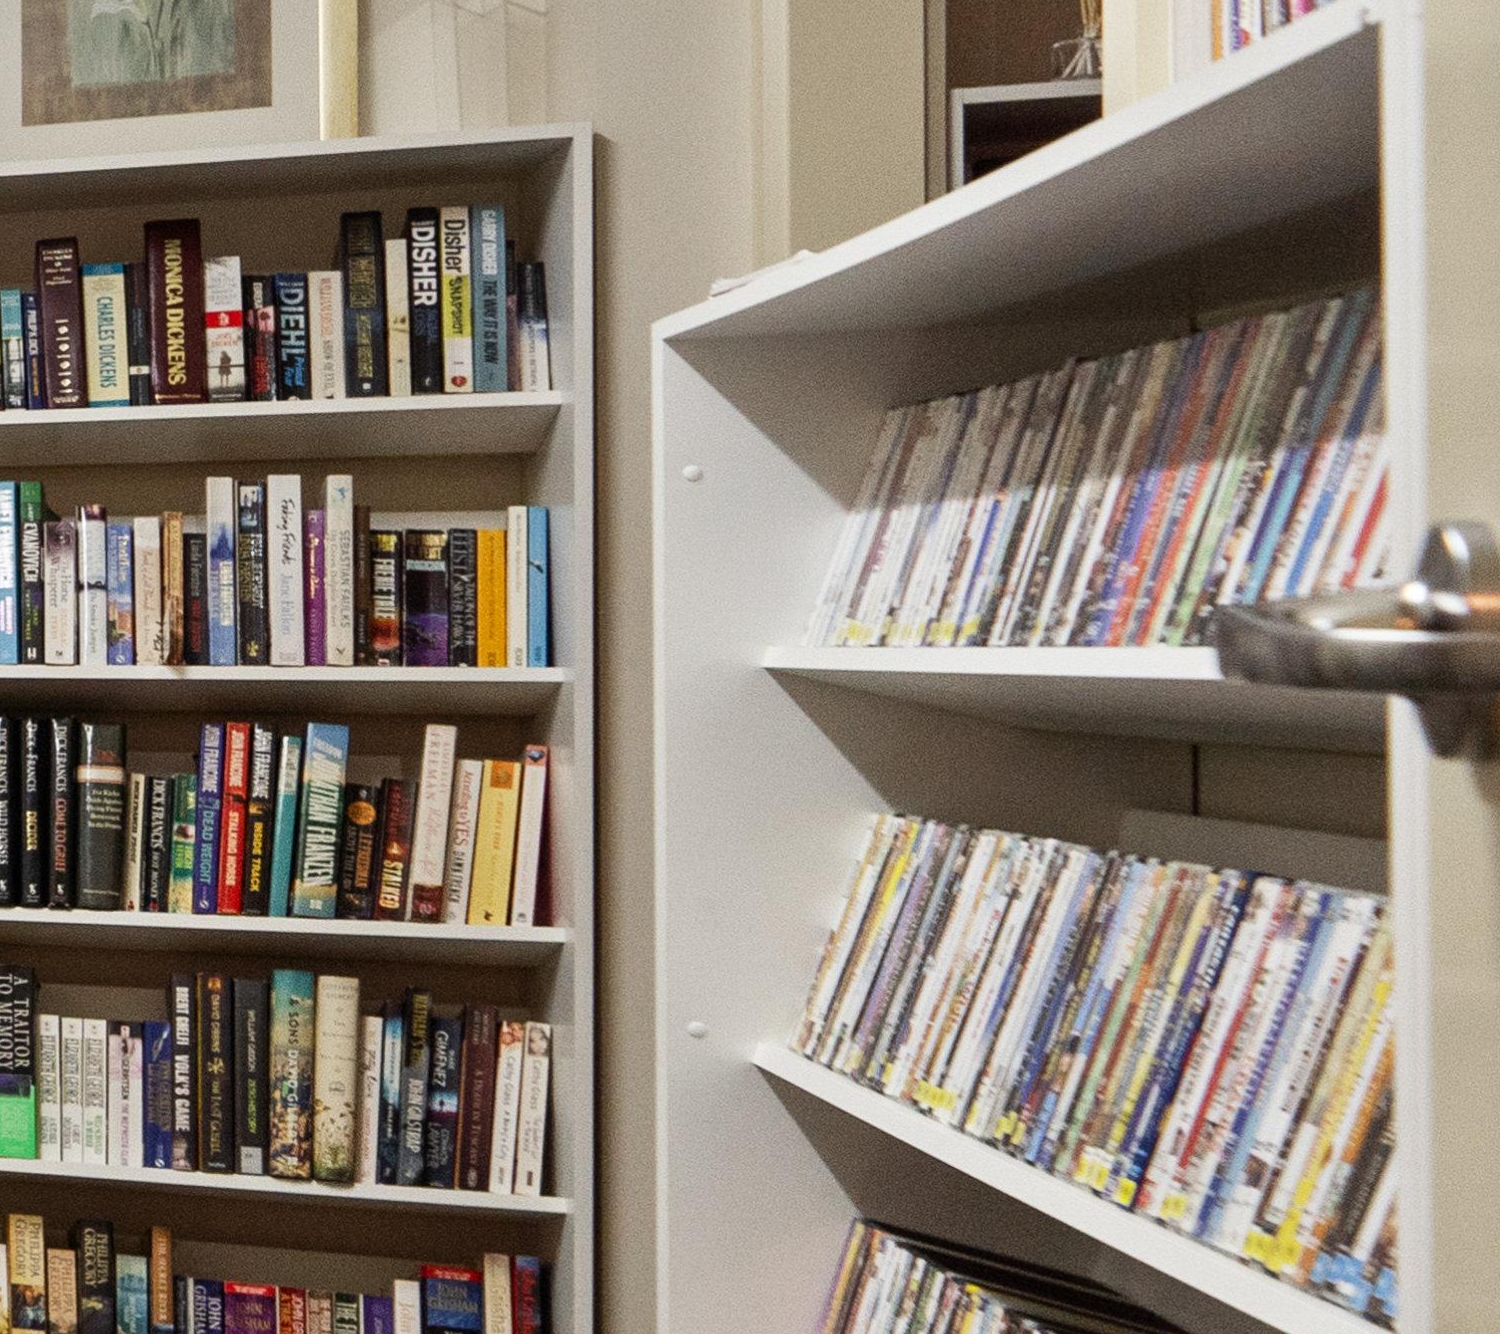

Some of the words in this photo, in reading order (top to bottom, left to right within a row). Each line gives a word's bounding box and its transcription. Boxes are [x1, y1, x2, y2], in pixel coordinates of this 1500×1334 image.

[163, 238, 184, 307] MONICA
[412, 224, 438, 307] DISHER
[443, 218, 466, 275] Disher
[96, 296, 114, 343] CHARLES
[166, 309, 187, 385] DICKENS
[98, 344, 117, 389] DICKENS
[11, 998, 30, 1069] TRAITOR
